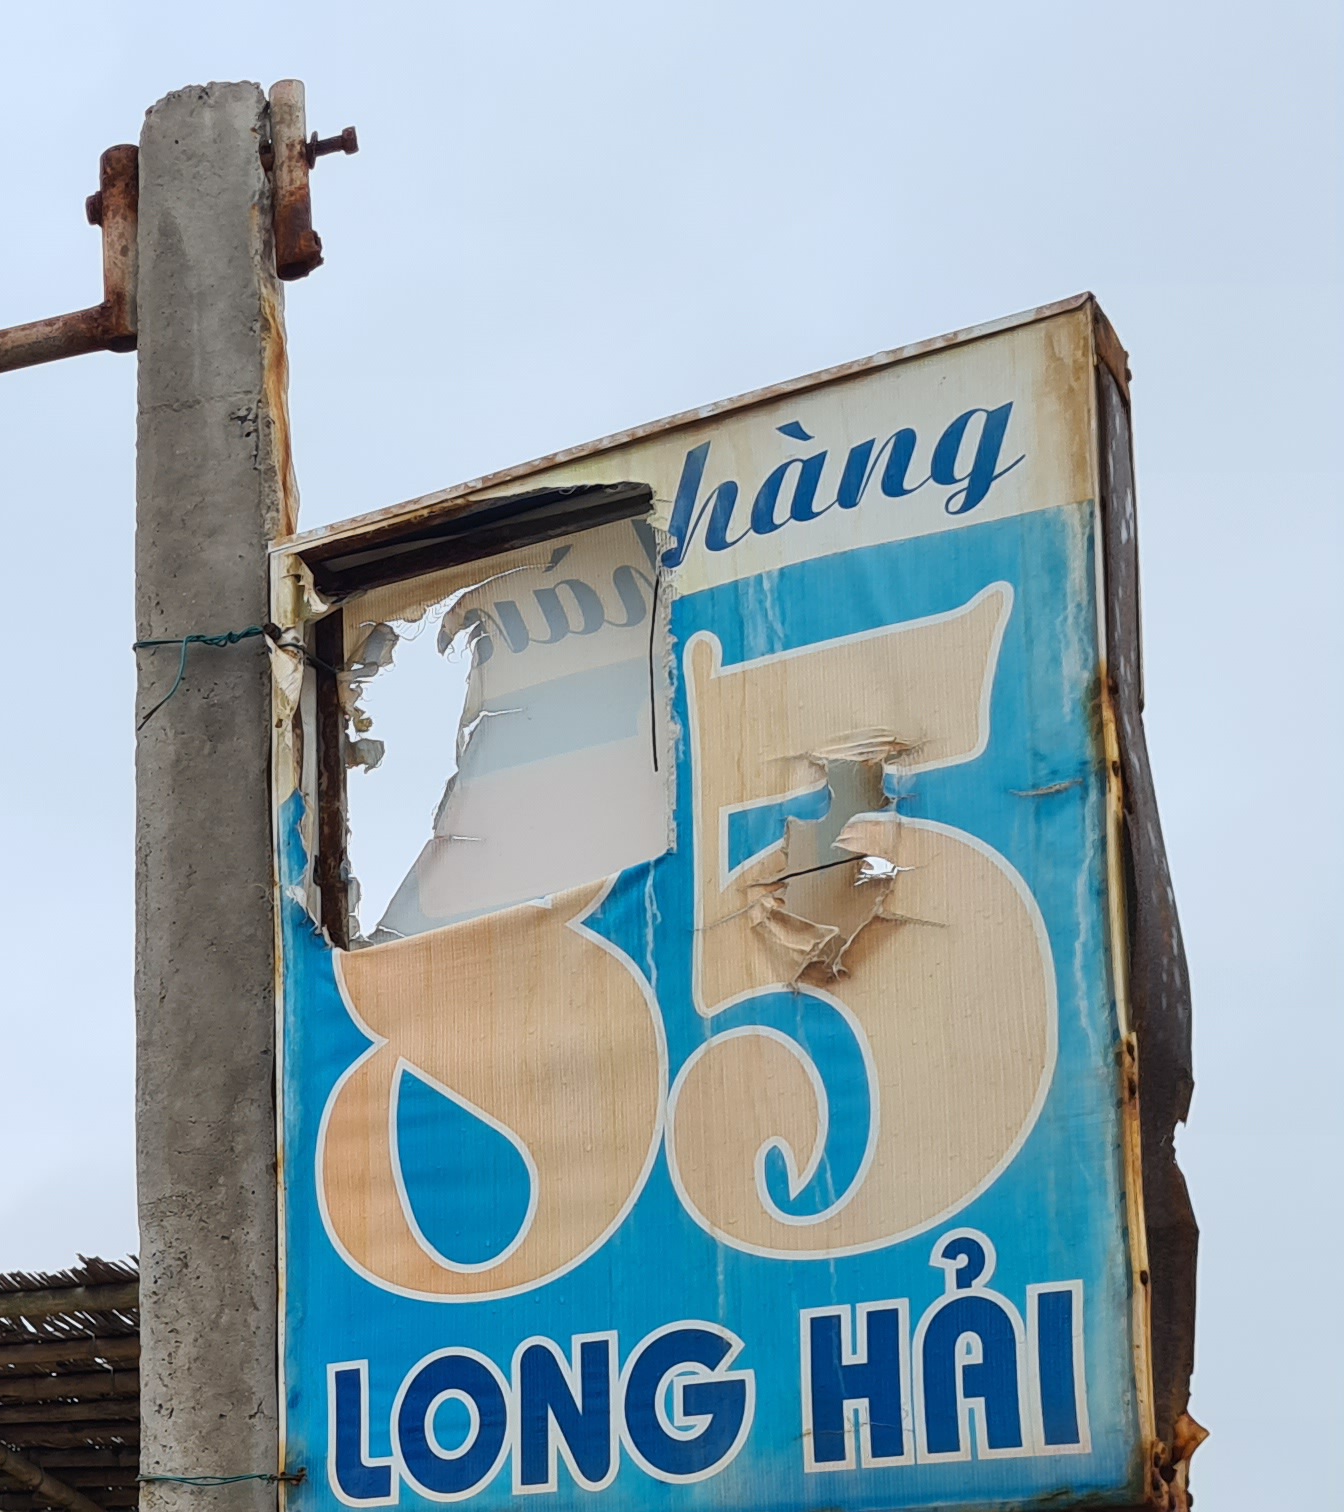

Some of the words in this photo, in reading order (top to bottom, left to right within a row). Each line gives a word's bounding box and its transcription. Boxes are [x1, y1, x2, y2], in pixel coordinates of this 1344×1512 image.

[661, 401, 1025, 569] hàng
[315, 580, 1058, 1303] 85
[327, 1319, 756, 1508] LONG
[799, 1227, 1091, 1472] HẢI
